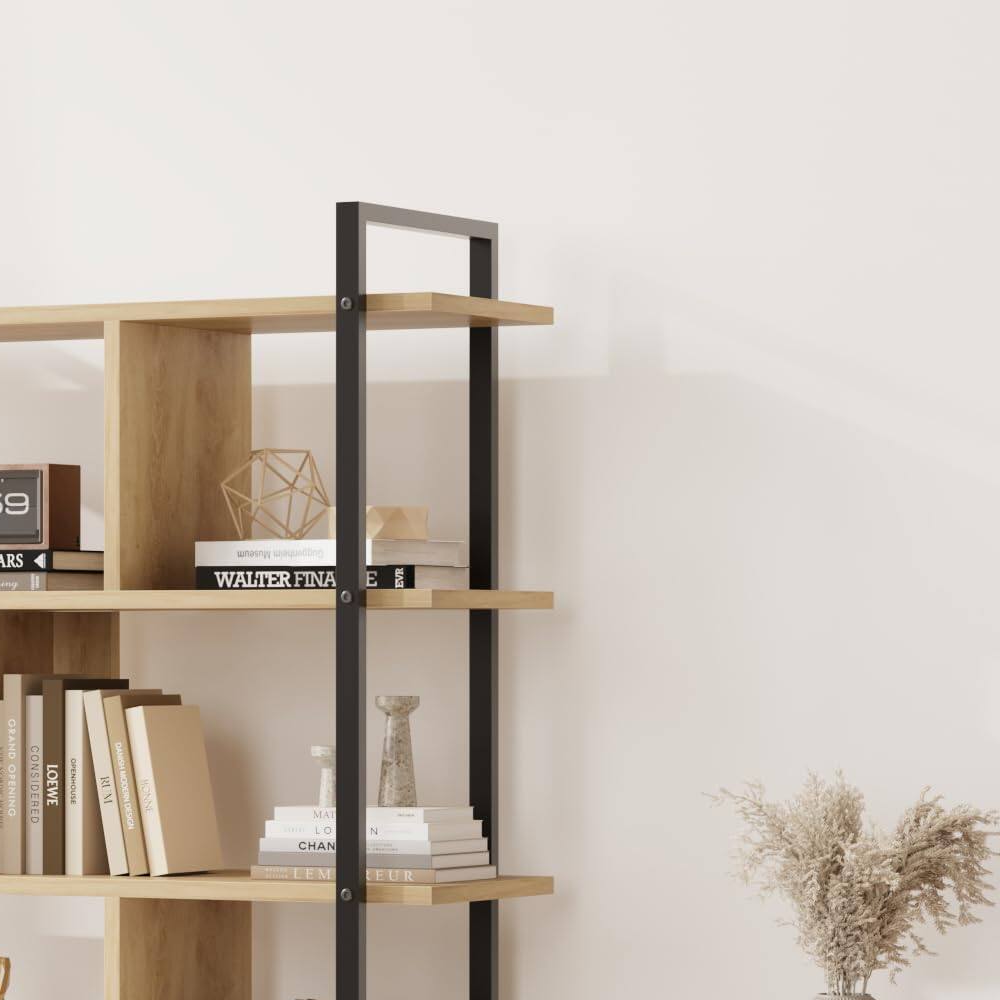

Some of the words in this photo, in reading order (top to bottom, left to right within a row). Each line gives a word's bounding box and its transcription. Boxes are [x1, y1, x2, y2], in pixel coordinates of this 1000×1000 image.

[236, 550, 271, 560] Museum
[213, 570, 292, 588] WALTER
[293, 570, 378, 588] FINAE
[7, 719, 16, 760] GRAND
[7, 764, 17, 817] OPENING
[30, 745, 40, 824] CONSIDERED
[46, 764, 59, 807] LOEWE
